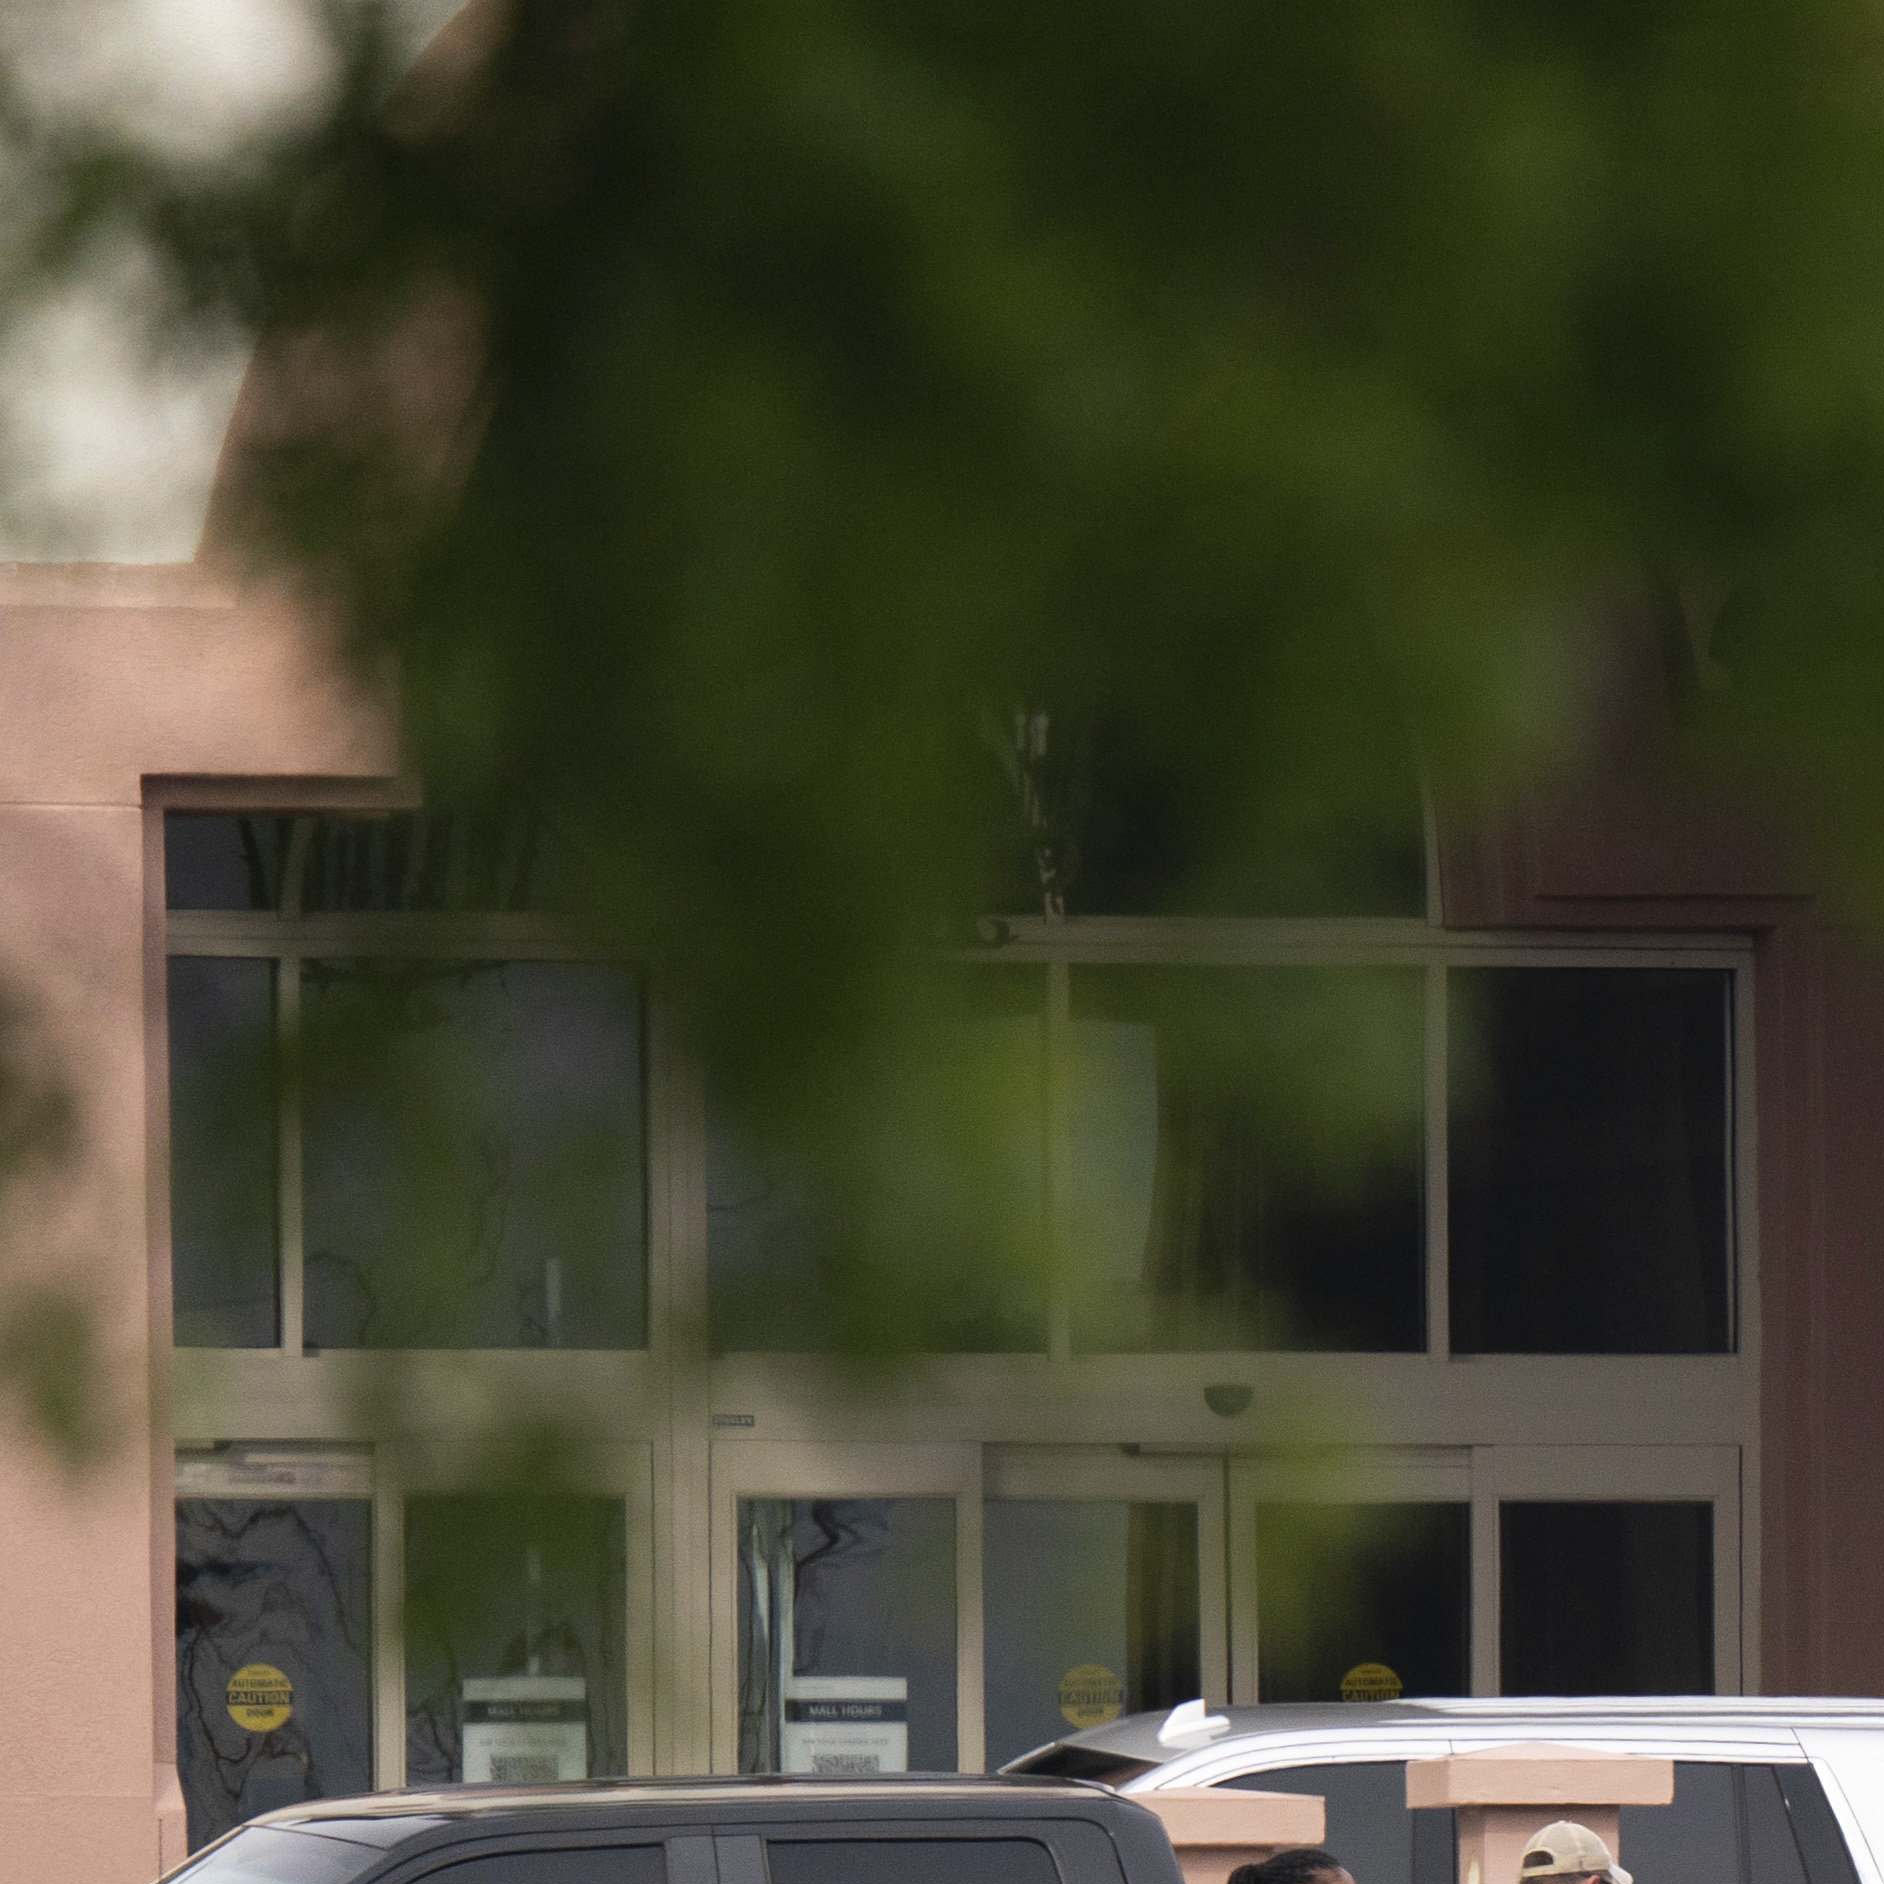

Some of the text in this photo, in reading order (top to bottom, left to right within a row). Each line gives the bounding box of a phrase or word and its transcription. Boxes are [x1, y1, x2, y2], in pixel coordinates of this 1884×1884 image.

[229, 1691, 290, 1703] CAUTION
[809, 1705, 882, 1718] MALL HOURS
